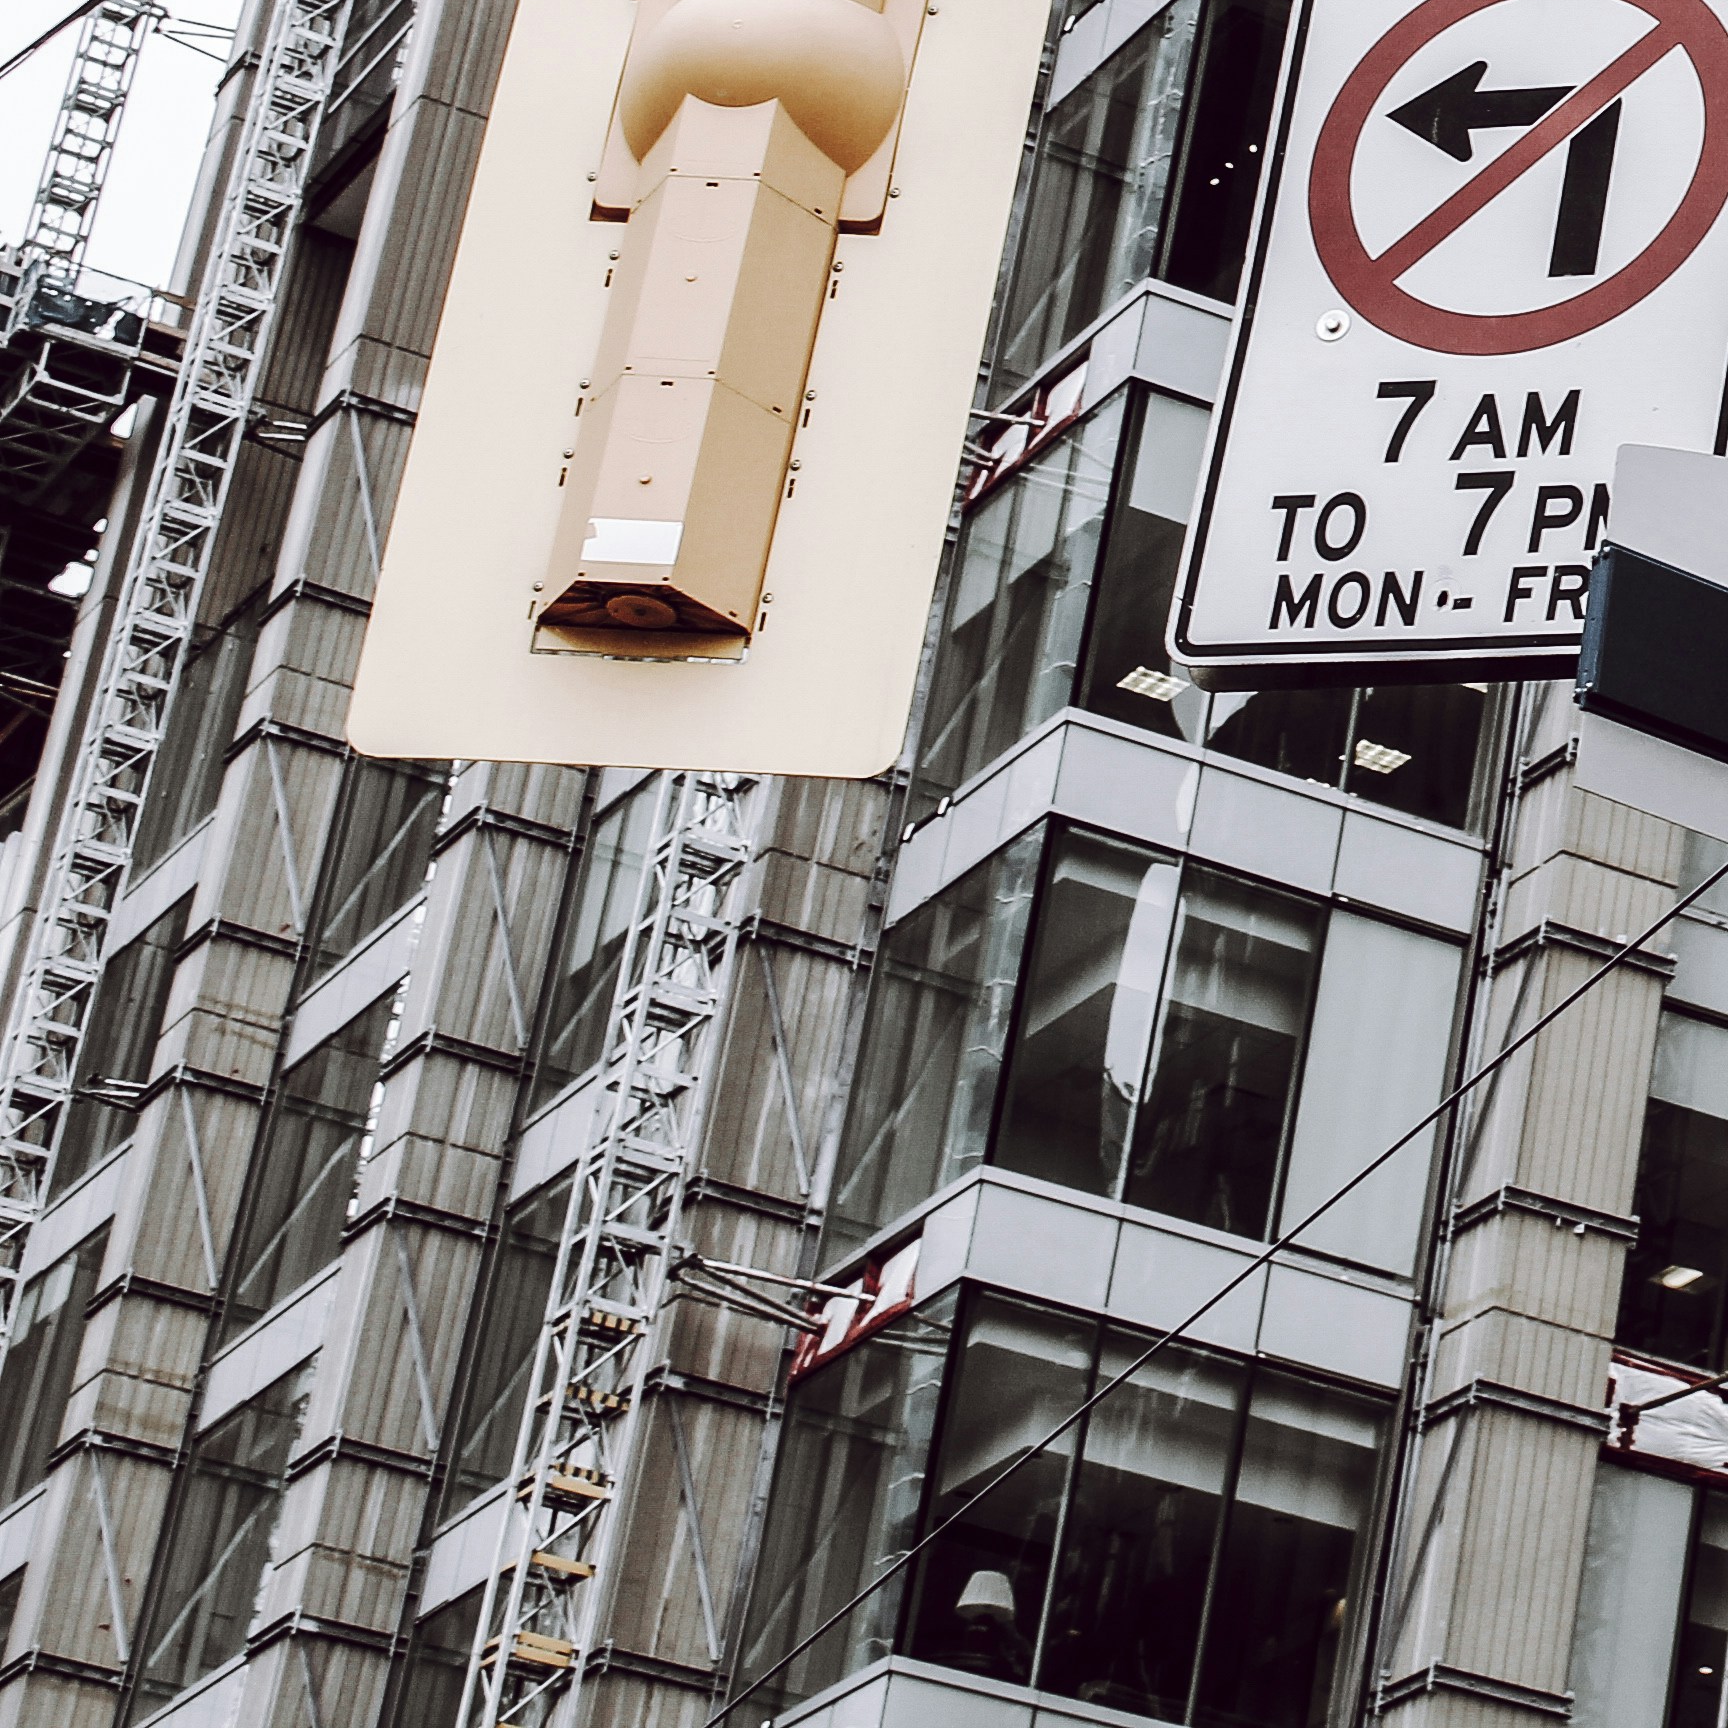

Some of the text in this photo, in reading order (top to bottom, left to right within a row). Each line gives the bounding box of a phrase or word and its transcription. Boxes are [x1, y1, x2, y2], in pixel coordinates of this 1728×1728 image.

[1376, 379, 1582, 464] 7 AM
[1271, 491, 1367, 562] TO
[1454, 470, 1516, 557] 7
[1268, 570, 1425, 630] MON
